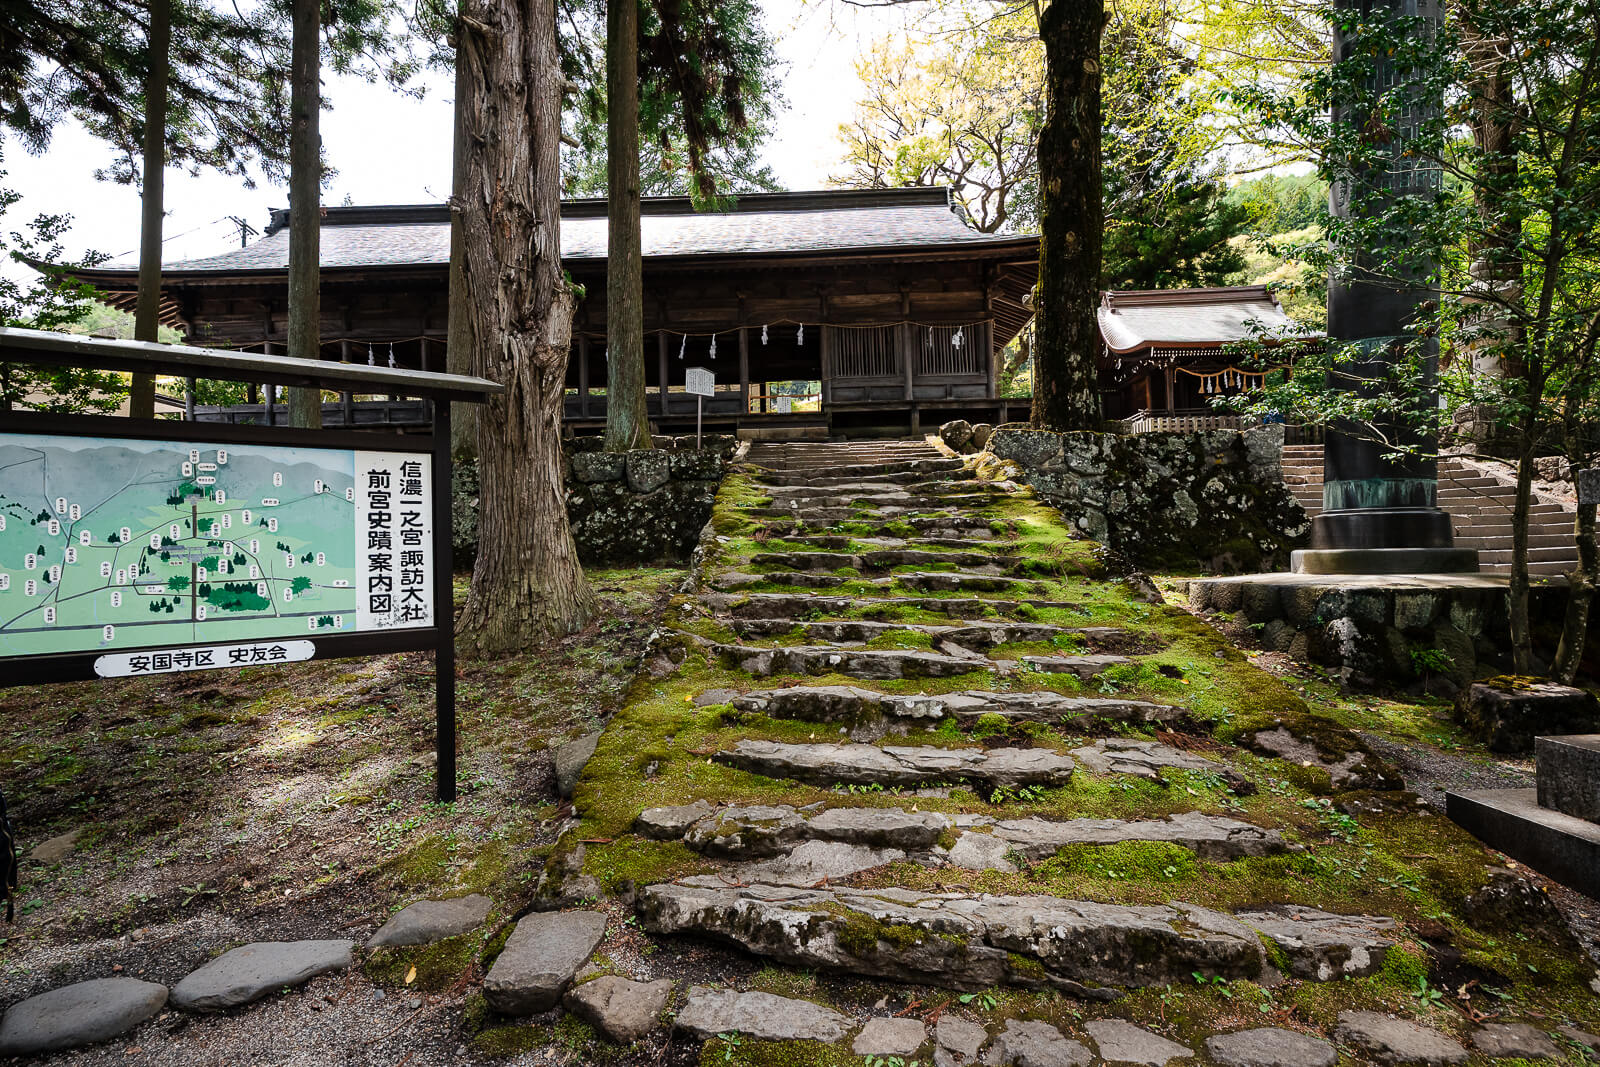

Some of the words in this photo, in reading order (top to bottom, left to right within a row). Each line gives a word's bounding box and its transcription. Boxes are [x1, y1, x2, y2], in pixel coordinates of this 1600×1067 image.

[367, 469, 393, 614] 前宮史蹟案内図
[400, 460, 423, 546] 信濃一之宮
[400, 550, 424, 622] 諏訪大社
[128, 649, 215, 673] 安国寺区
[228, 645, 288, 664] 史友会
